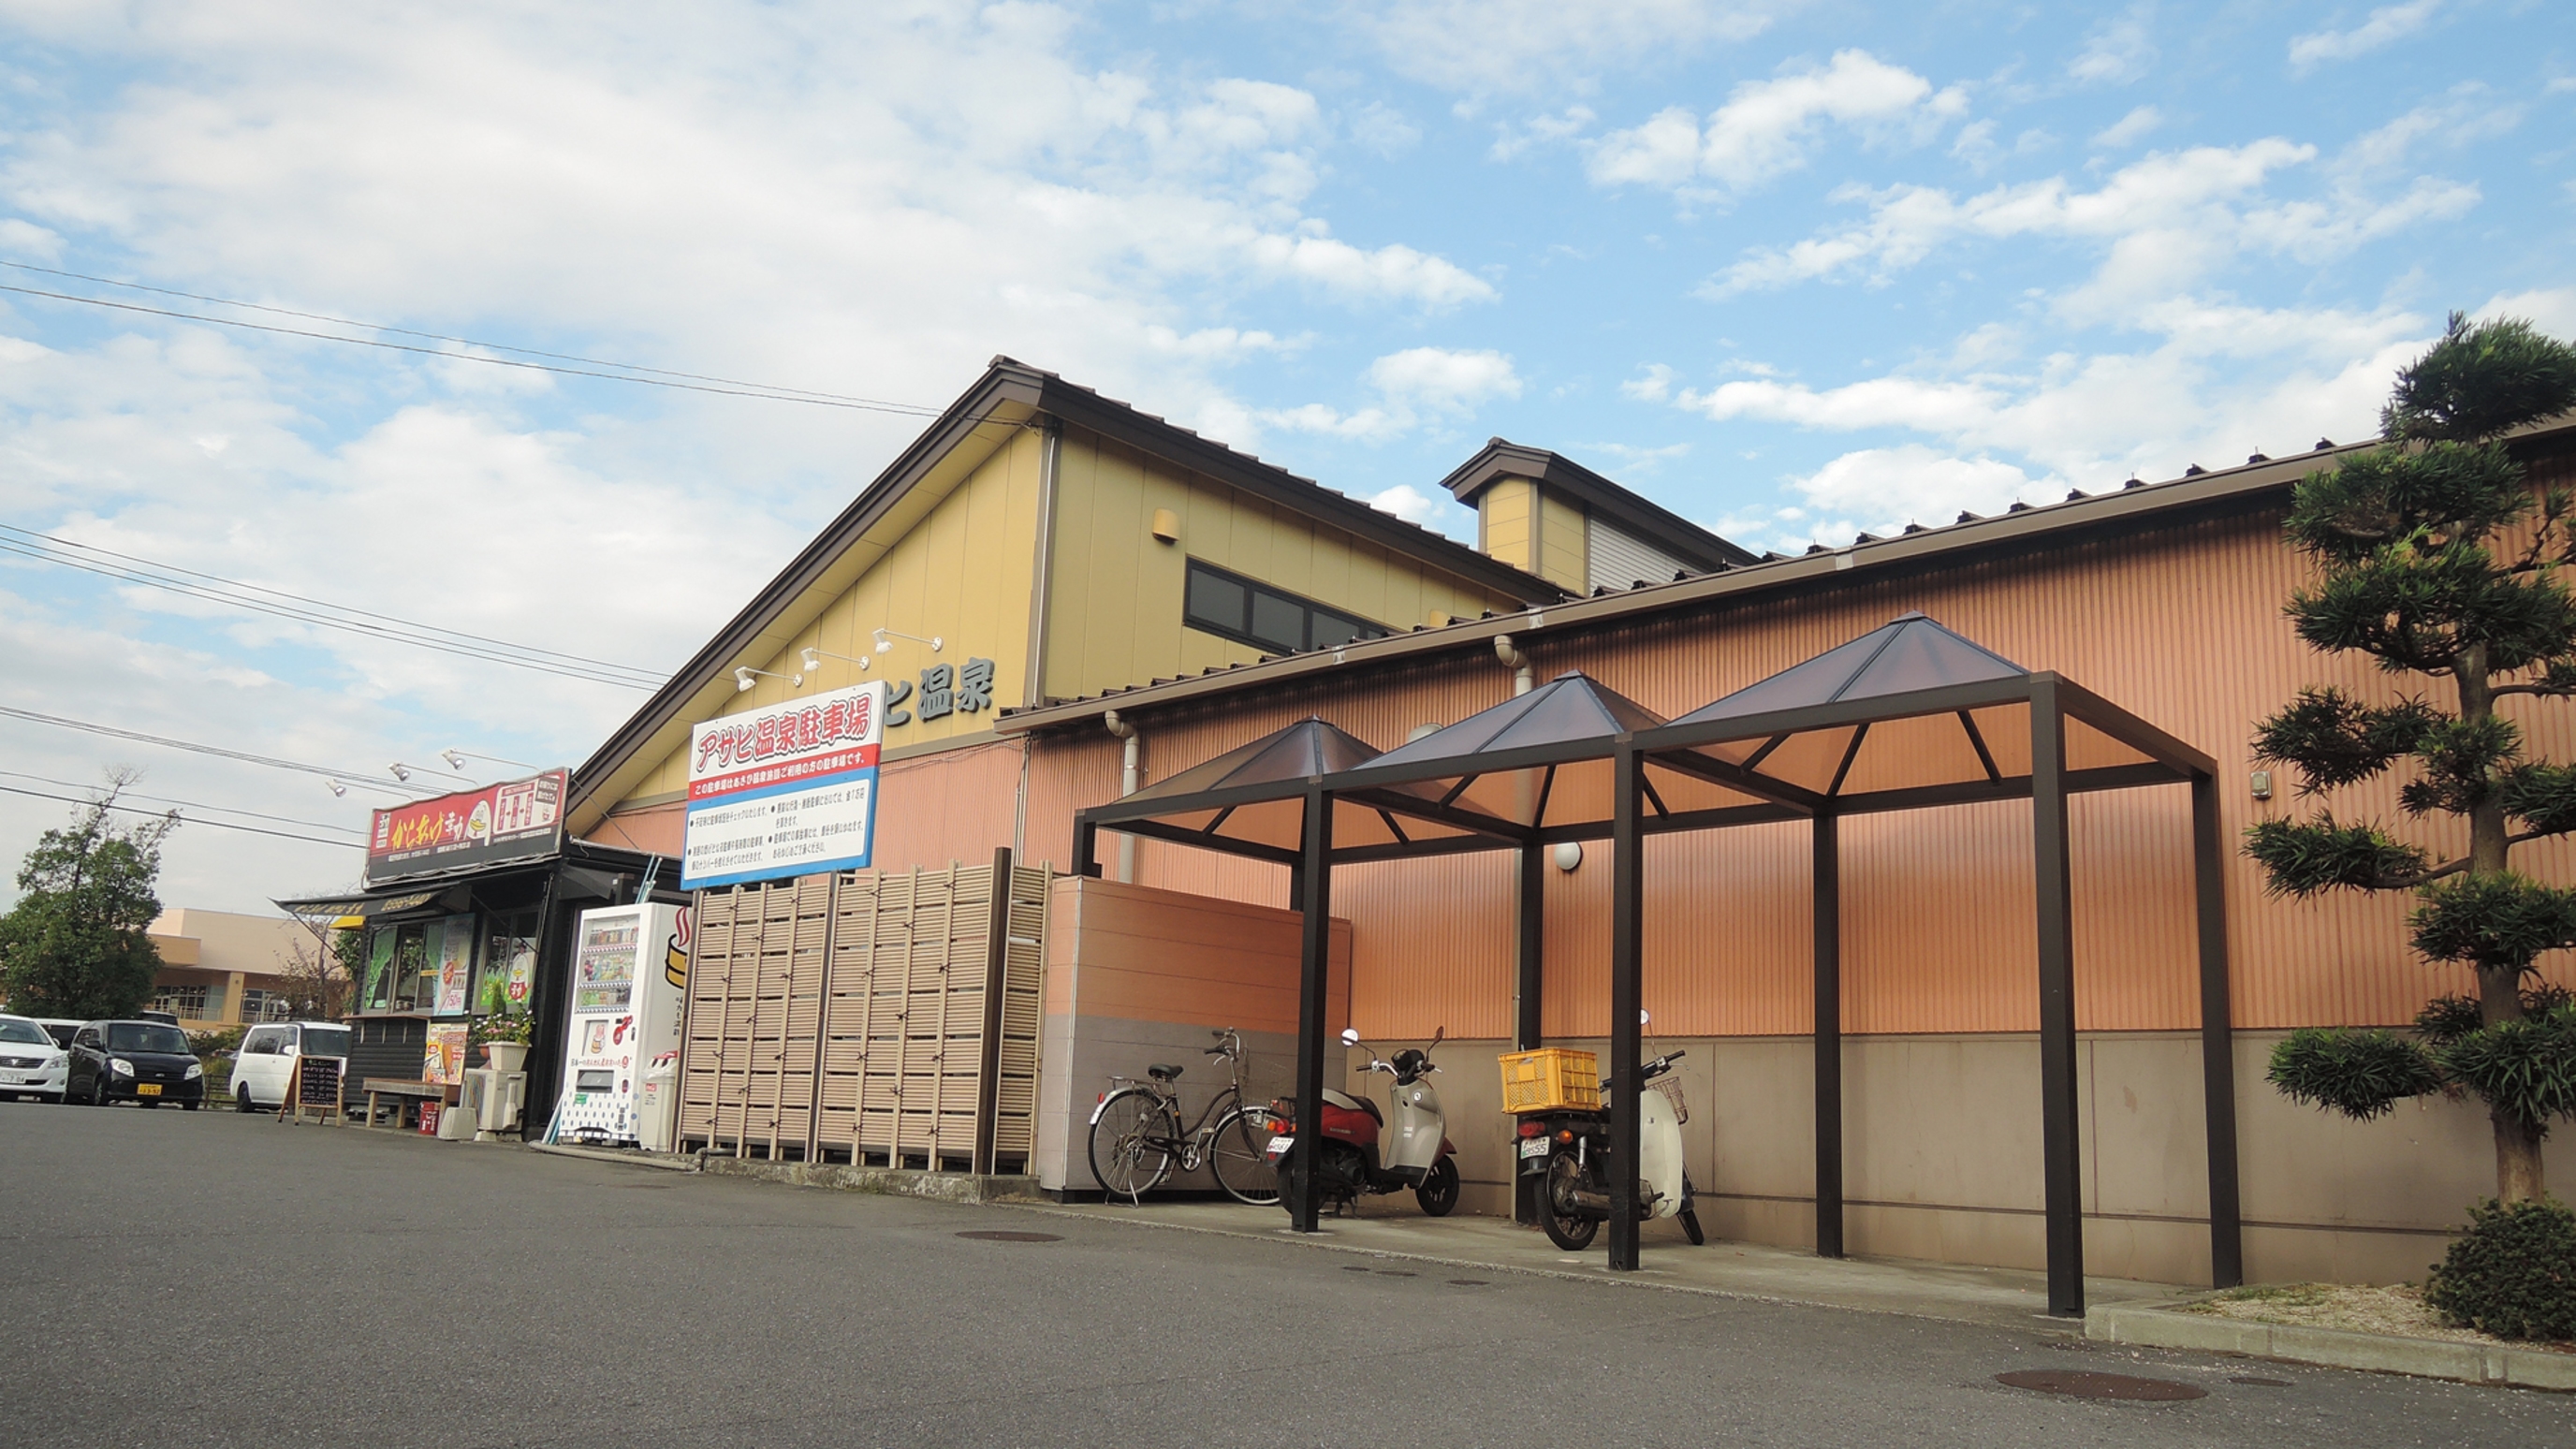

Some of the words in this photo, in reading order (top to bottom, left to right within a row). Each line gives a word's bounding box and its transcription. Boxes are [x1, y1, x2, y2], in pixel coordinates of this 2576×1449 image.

[695, 694, 872, 772] アサヒ温泉駐車場
